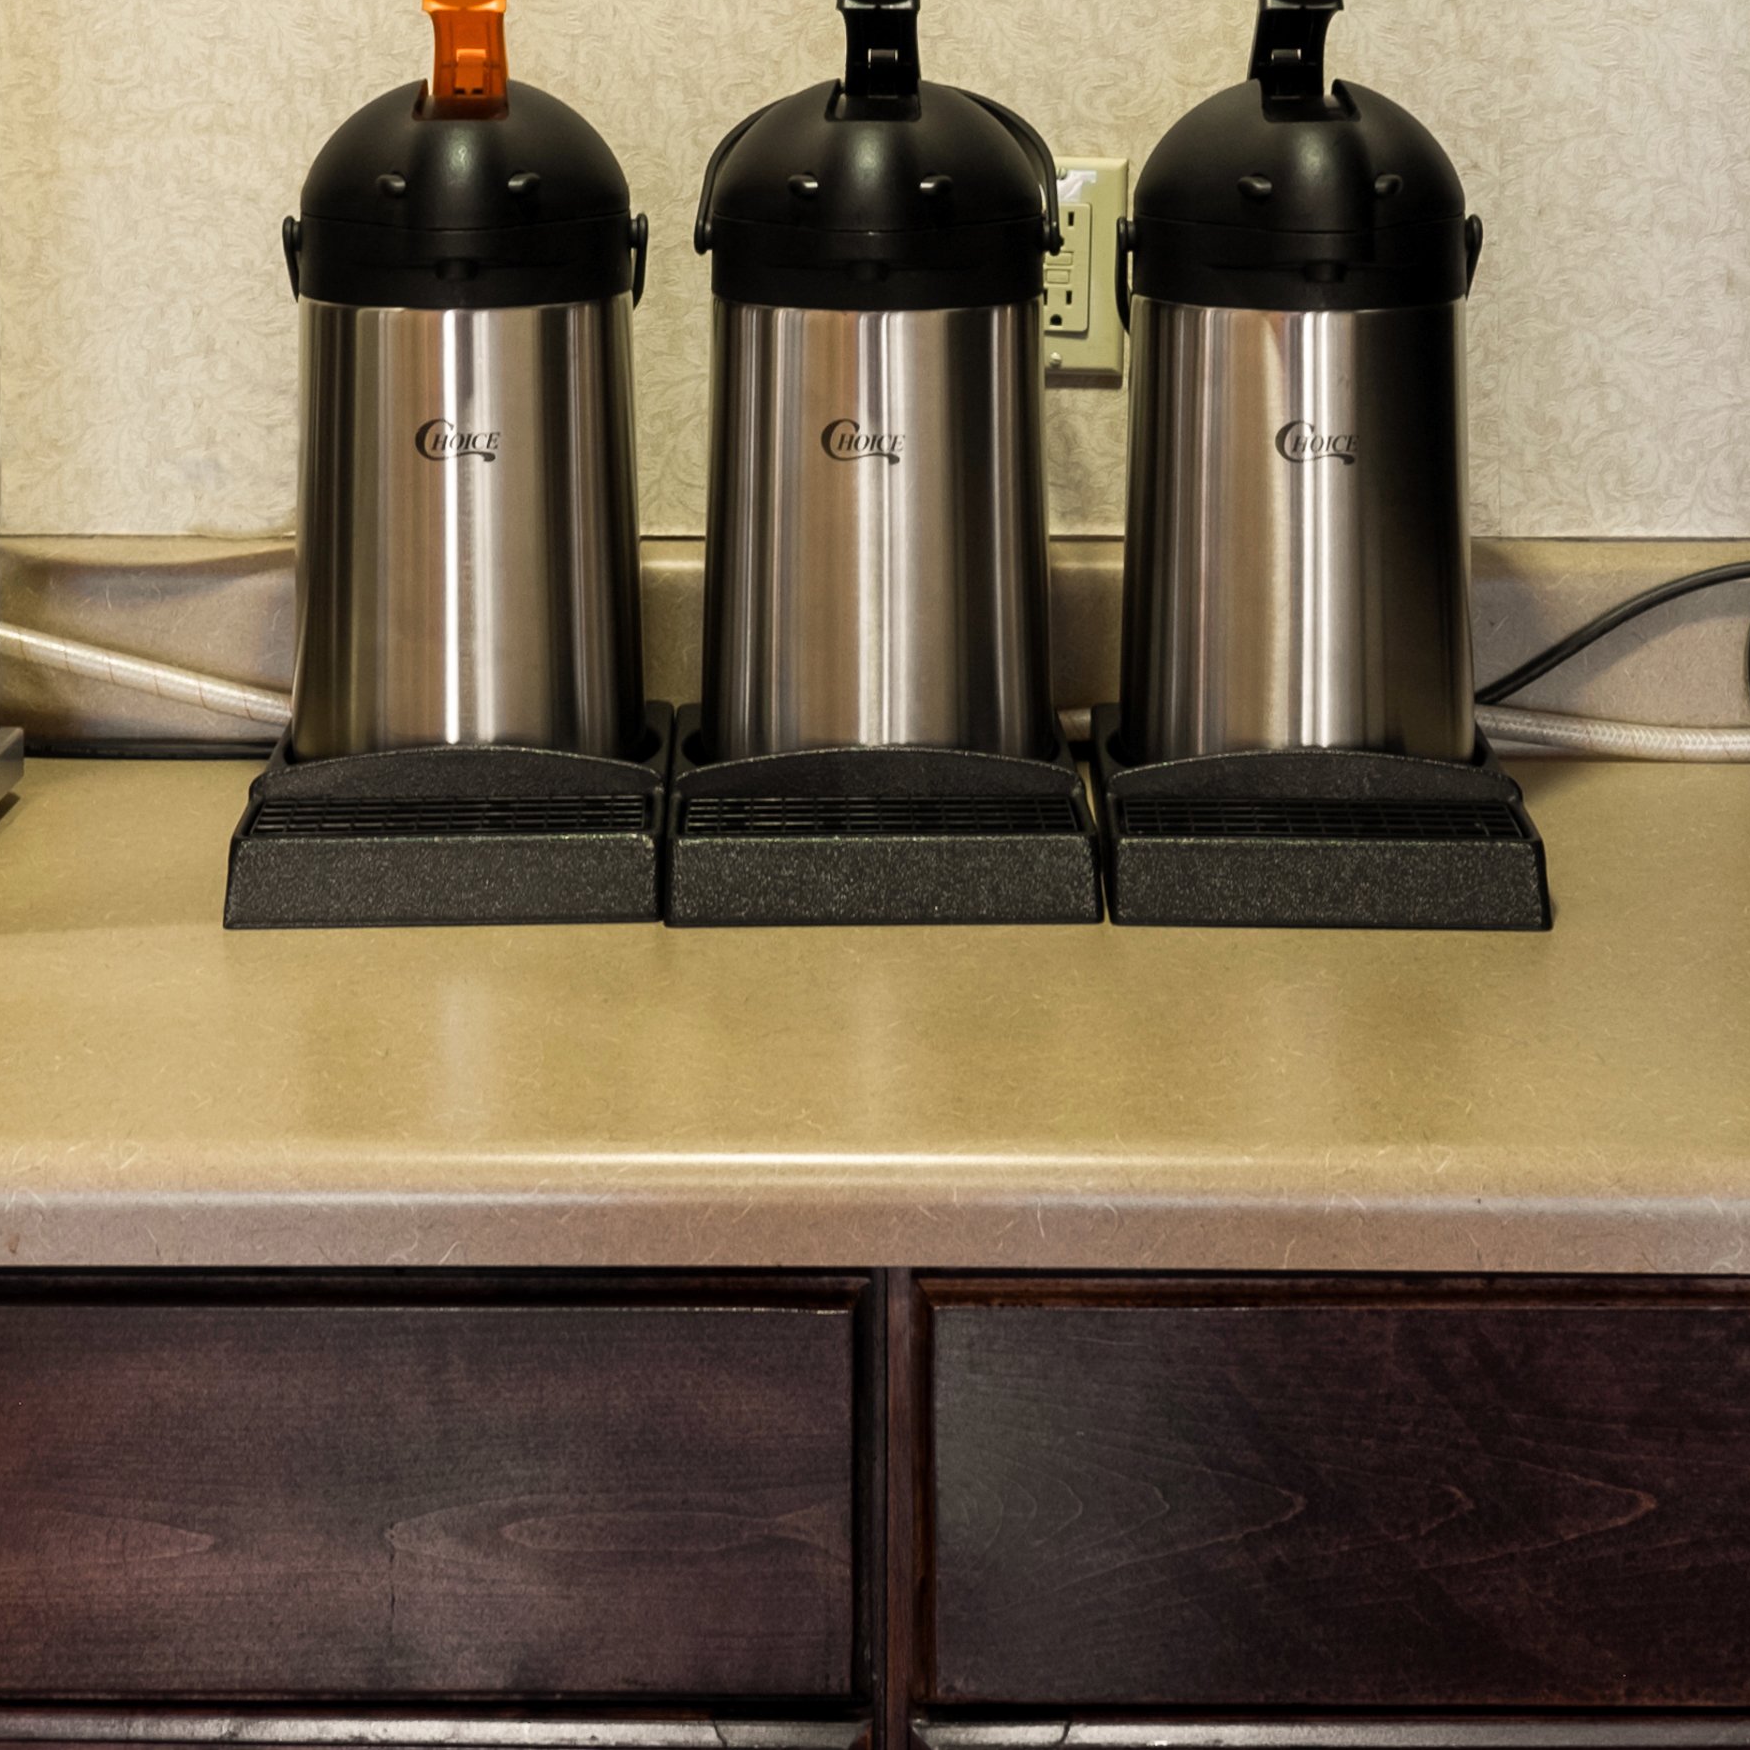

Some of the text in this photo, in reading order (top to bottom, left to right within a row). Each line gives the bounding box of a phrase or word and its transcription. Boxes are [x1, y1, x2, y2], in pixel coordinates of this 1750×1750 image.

[414, 417, 501, 463] CHOICE
[820, 418, 906, 465] CHOICE
[1274, 419, 1360, 465] CHOICE
